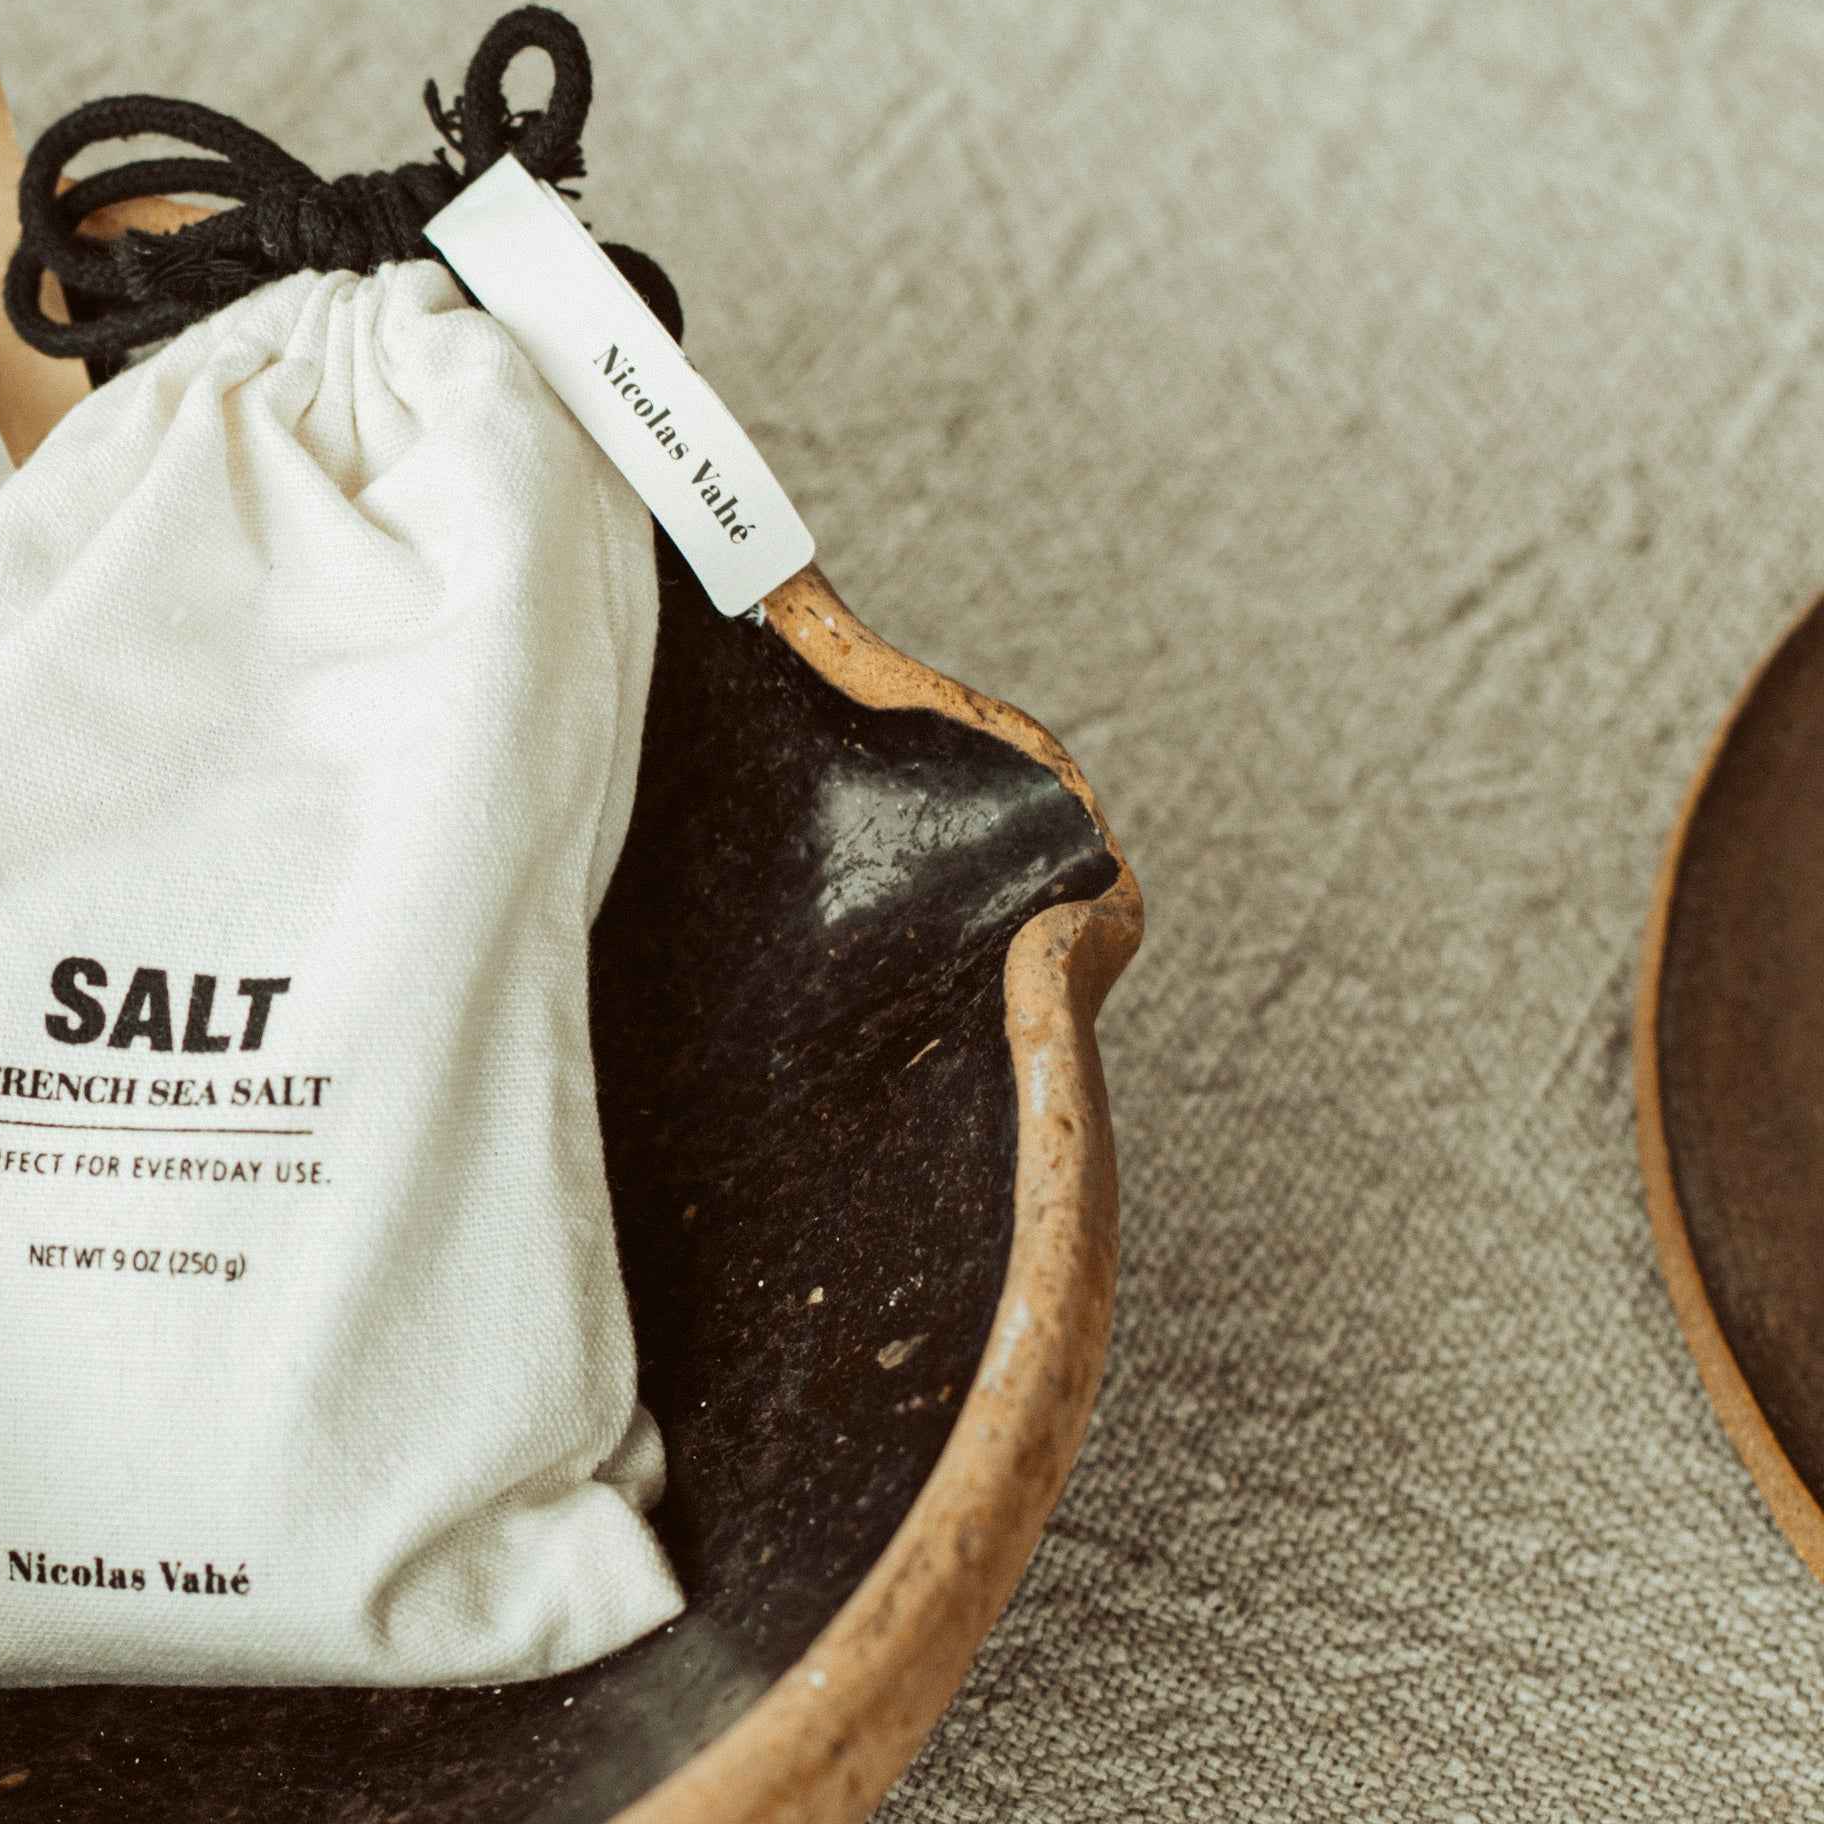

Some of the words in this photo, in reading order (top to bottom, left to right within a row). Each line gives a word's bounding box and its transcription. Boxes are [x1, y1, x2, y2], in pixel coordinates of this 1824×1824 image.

[592, 343, 689, 462] Nicolas
[690, 458, 760, 545] Vahé
[45, 956, 291, 1053] SALT
[147, 1077, 218, 1106] SEA
[230, 1075, 332, 1107] SALT
[75, 1154, 120, 1178] FOR
[132, 1157, 263, 1184] EVERYDAY
[276, 1161, 332, 1184] USE.
[29, 1243, 68, 1268] NET
[75, 1247, 105, 1271] WT
[112, 1248, 126, 1272] 9
[130, 1250, 162, 1273] OZ
[169, 1250, 218, 1276] (250
[223, 1253, 248, 1281] g)
[7, 1549, 146, 1592] Nicolas
[159, 1559, 251, 1596] Vahé
